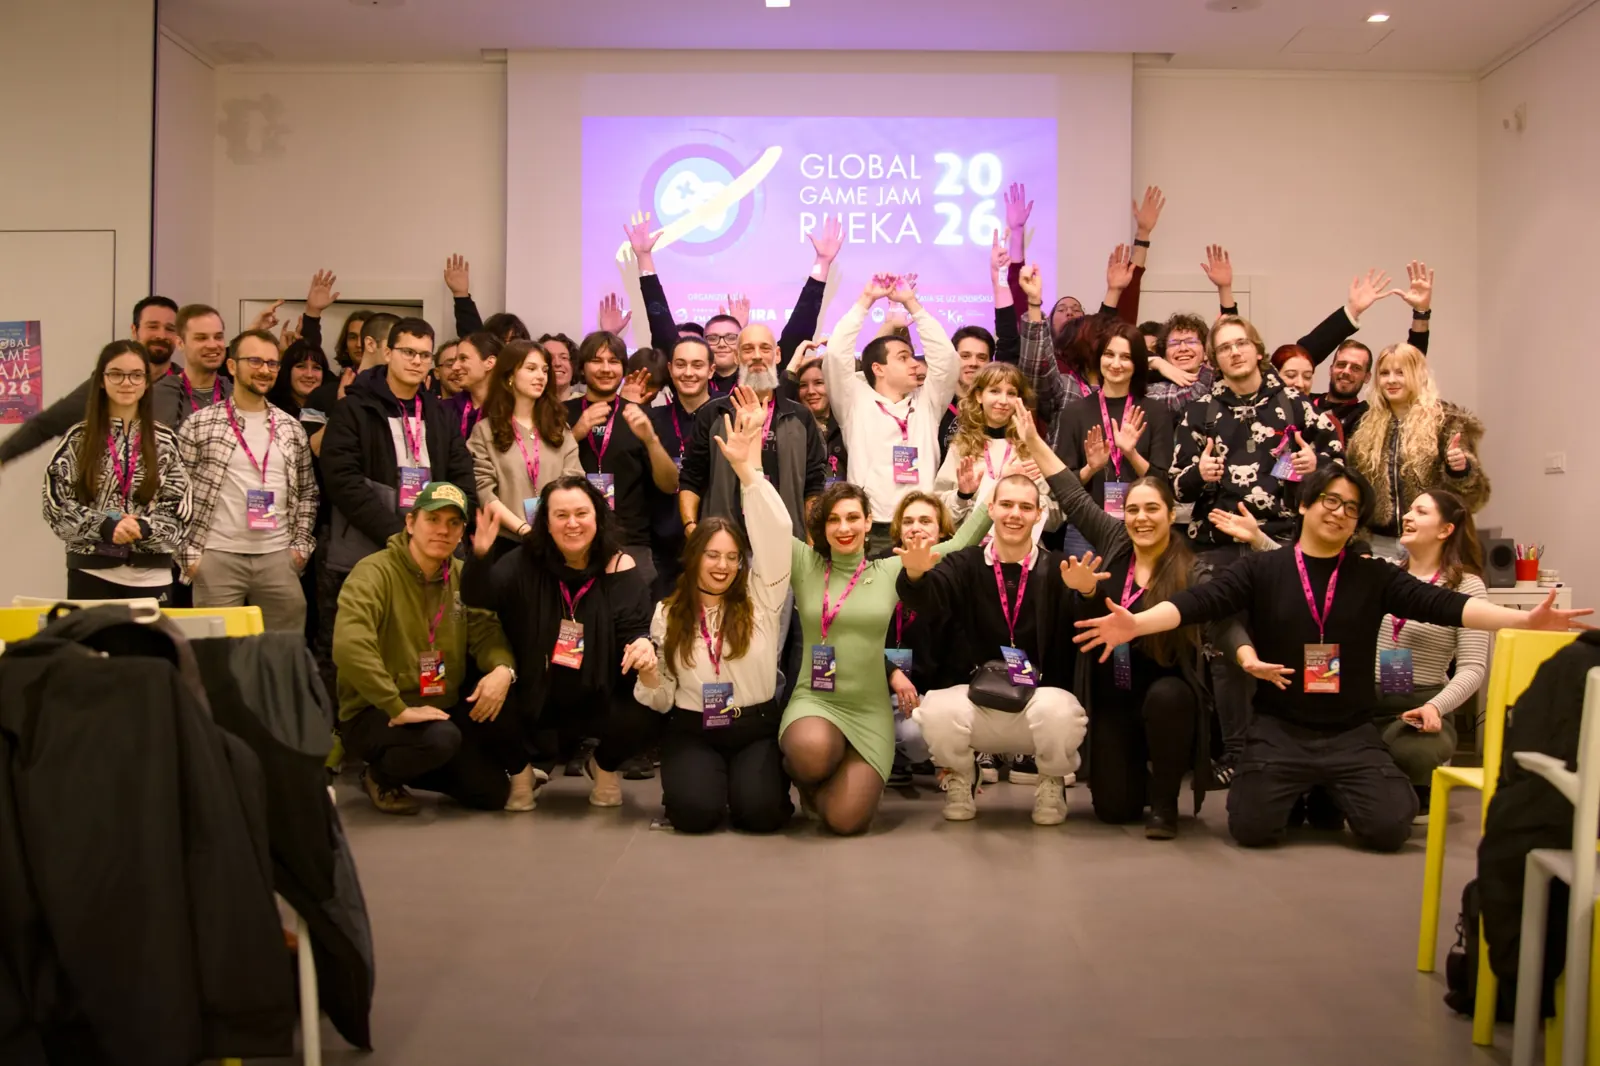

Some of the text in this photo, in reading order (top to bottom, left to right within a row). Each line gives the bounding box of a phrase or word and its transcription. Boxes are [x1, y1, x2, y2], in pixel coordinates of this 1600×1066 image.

[799, 152, 922, 180] GLOBAL
[932, 151, 1004, 196] 20
[799, 185, 922, 207] GAME JAM
[932, 199, 1003, 246] 26
[0, 338, 30, 349] OBAL
[0, 349, 30, 361] AME
[0, 362, 30, 379] AM
[0, 380, 31, 395] 026
